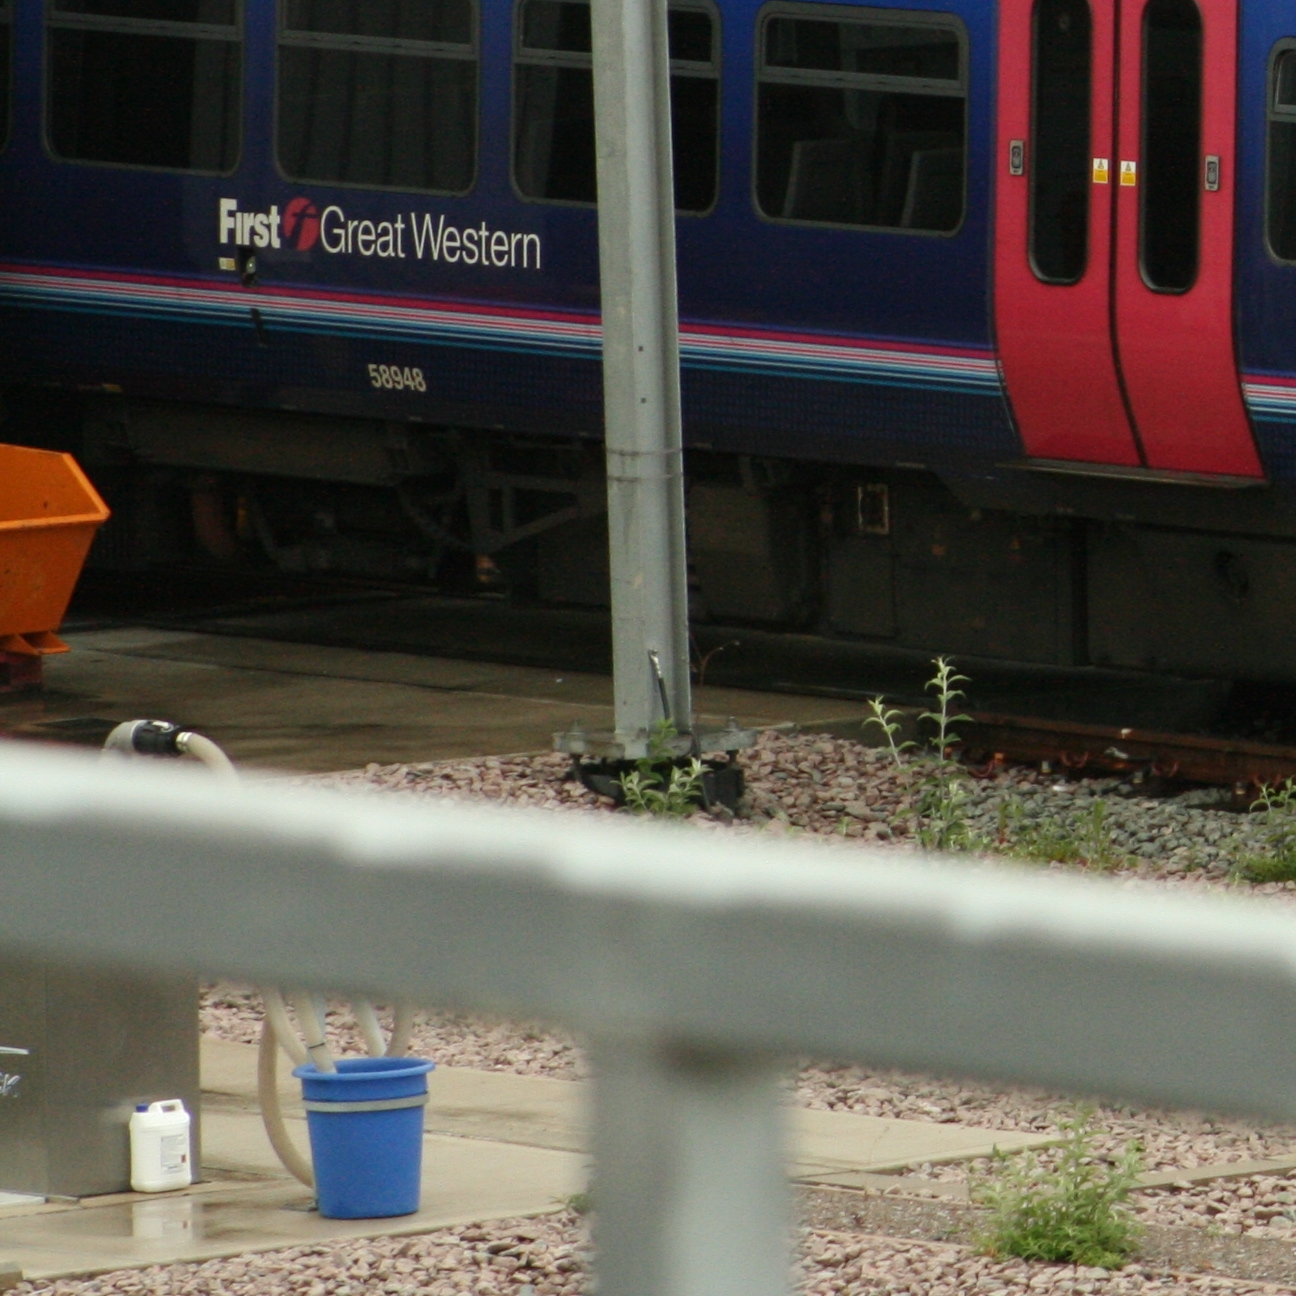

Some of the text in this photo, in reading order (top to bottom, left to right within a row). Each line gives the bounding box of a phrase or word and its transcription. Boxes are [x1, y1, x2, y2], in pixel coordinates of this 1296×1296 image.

[219, 197, 541, 269] First Great Western
[367, 363, 427, 393] 58948
